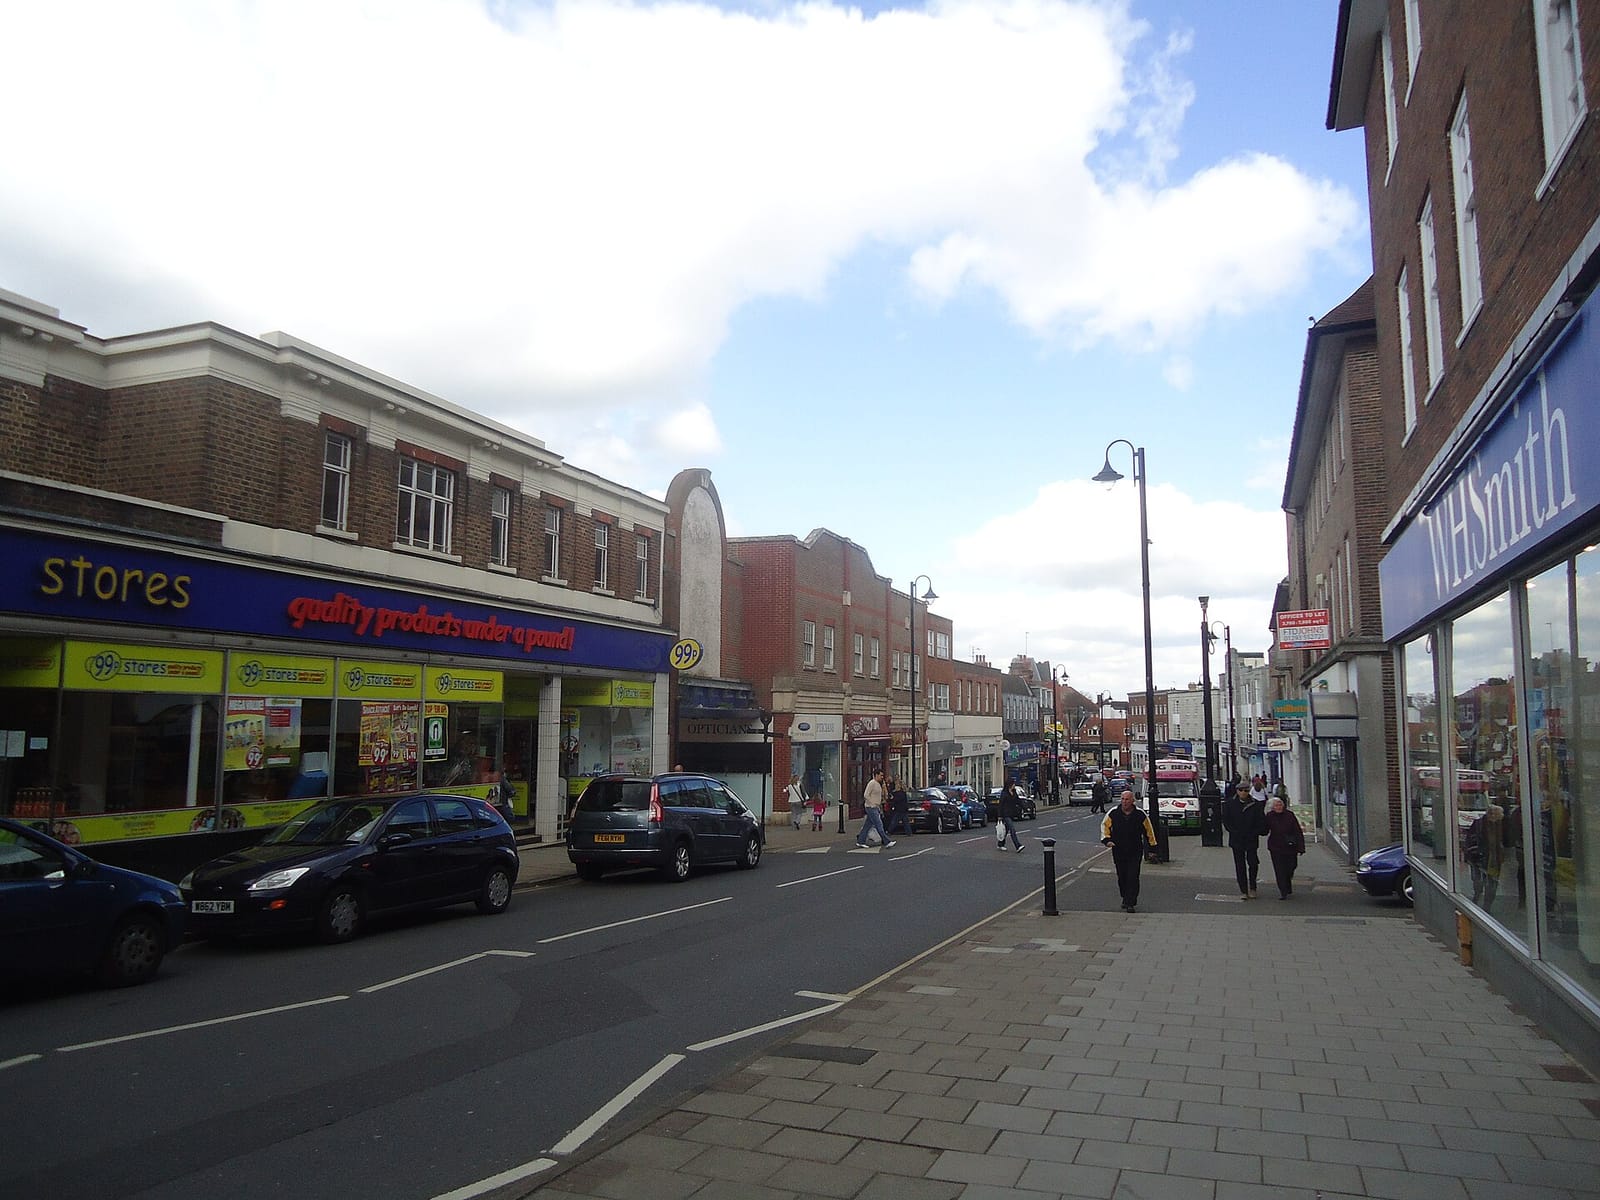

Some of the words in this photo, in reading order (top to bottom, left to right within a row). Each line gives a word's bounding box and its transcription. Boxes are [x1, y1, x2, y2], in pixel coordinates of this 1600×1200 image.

[1418, 369, 1576, 600] WHSmith
[41, 556, 192, 608] stores
[288, 592, 375, 635] quality
[374, 605, 462, 637] products
[463, 616, 512, 641] under
[512, 628, 525, 643] a
[525, 627, 576, 652] pound!
[95, 654, 119, 676] 99p
[124, 660, 167, 674] stores
[675, 643, 698, 665] 99p
[265, 668, 298, 681] stores
[366, 674, 393, 686] stores
[453, 678, 475, 689] stores
